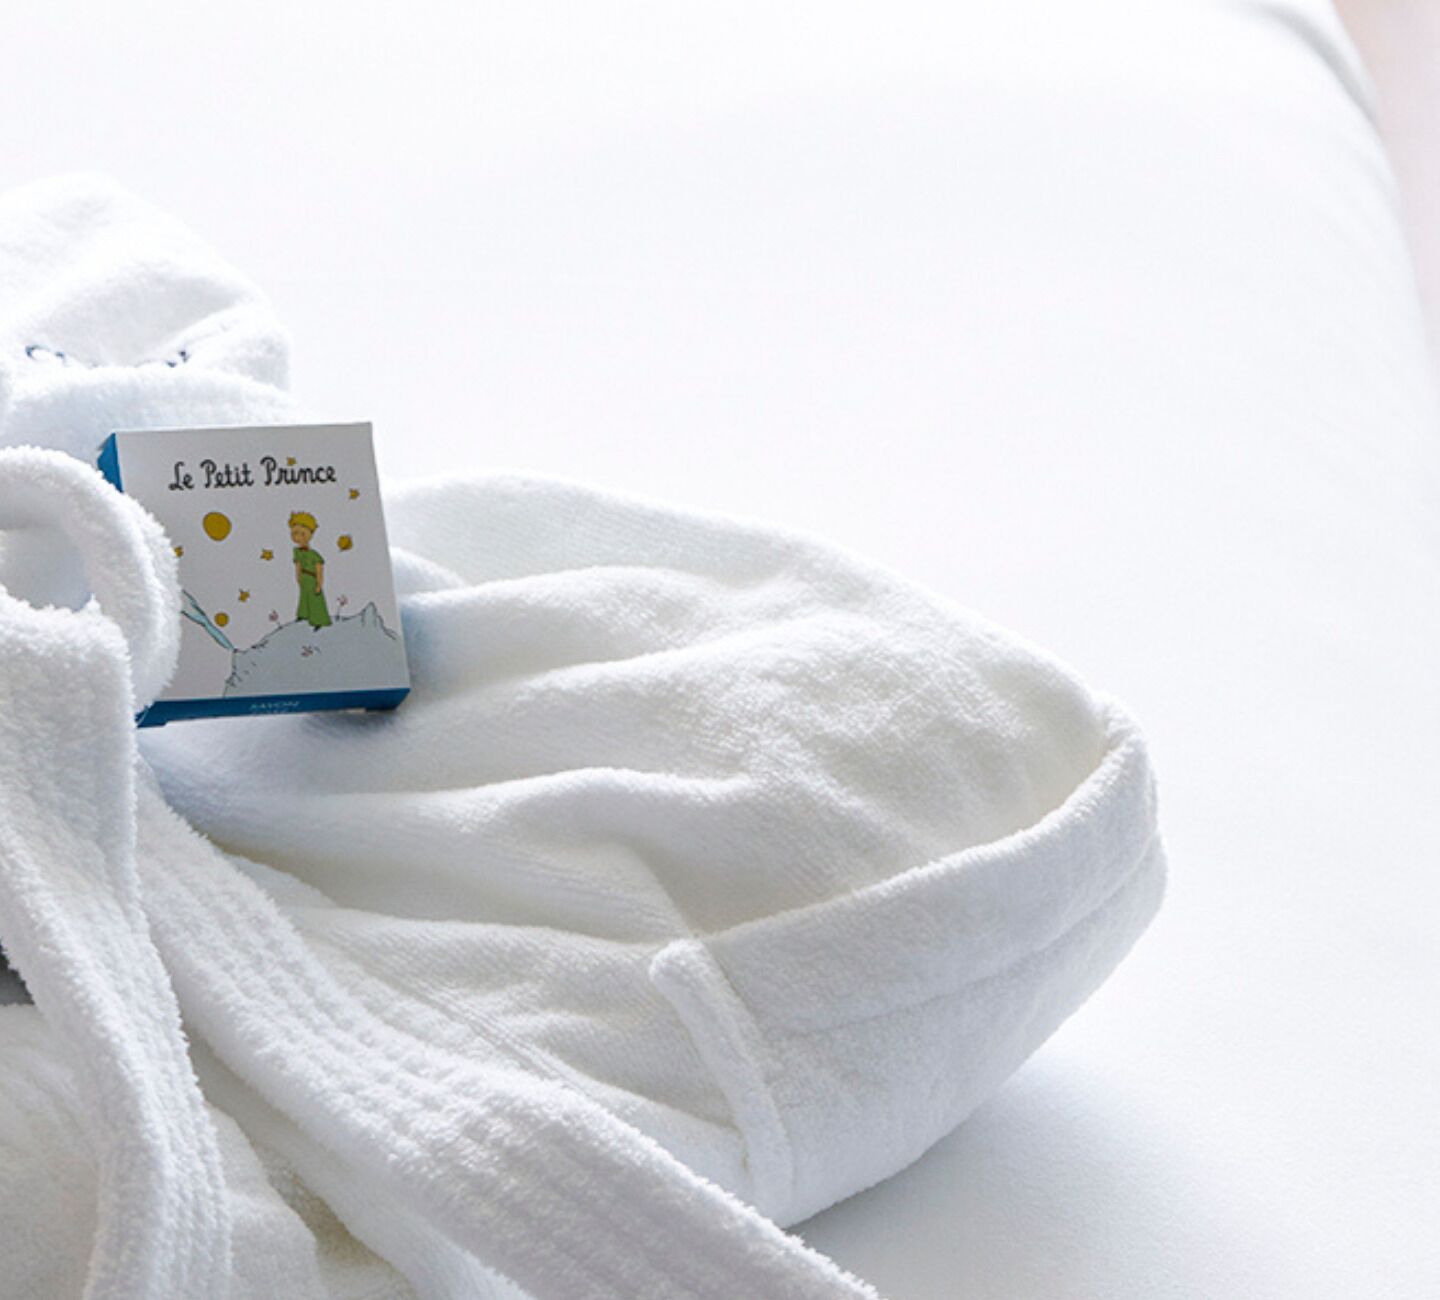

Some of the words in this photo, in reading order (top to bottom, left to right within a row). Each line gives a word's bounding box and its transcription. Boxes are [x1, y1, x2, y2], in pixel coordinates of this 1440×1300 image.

[168, 461, 194, 491] Le
[200, 459, 254, 488] Petit
[260, 456, 337, 486] Prince
